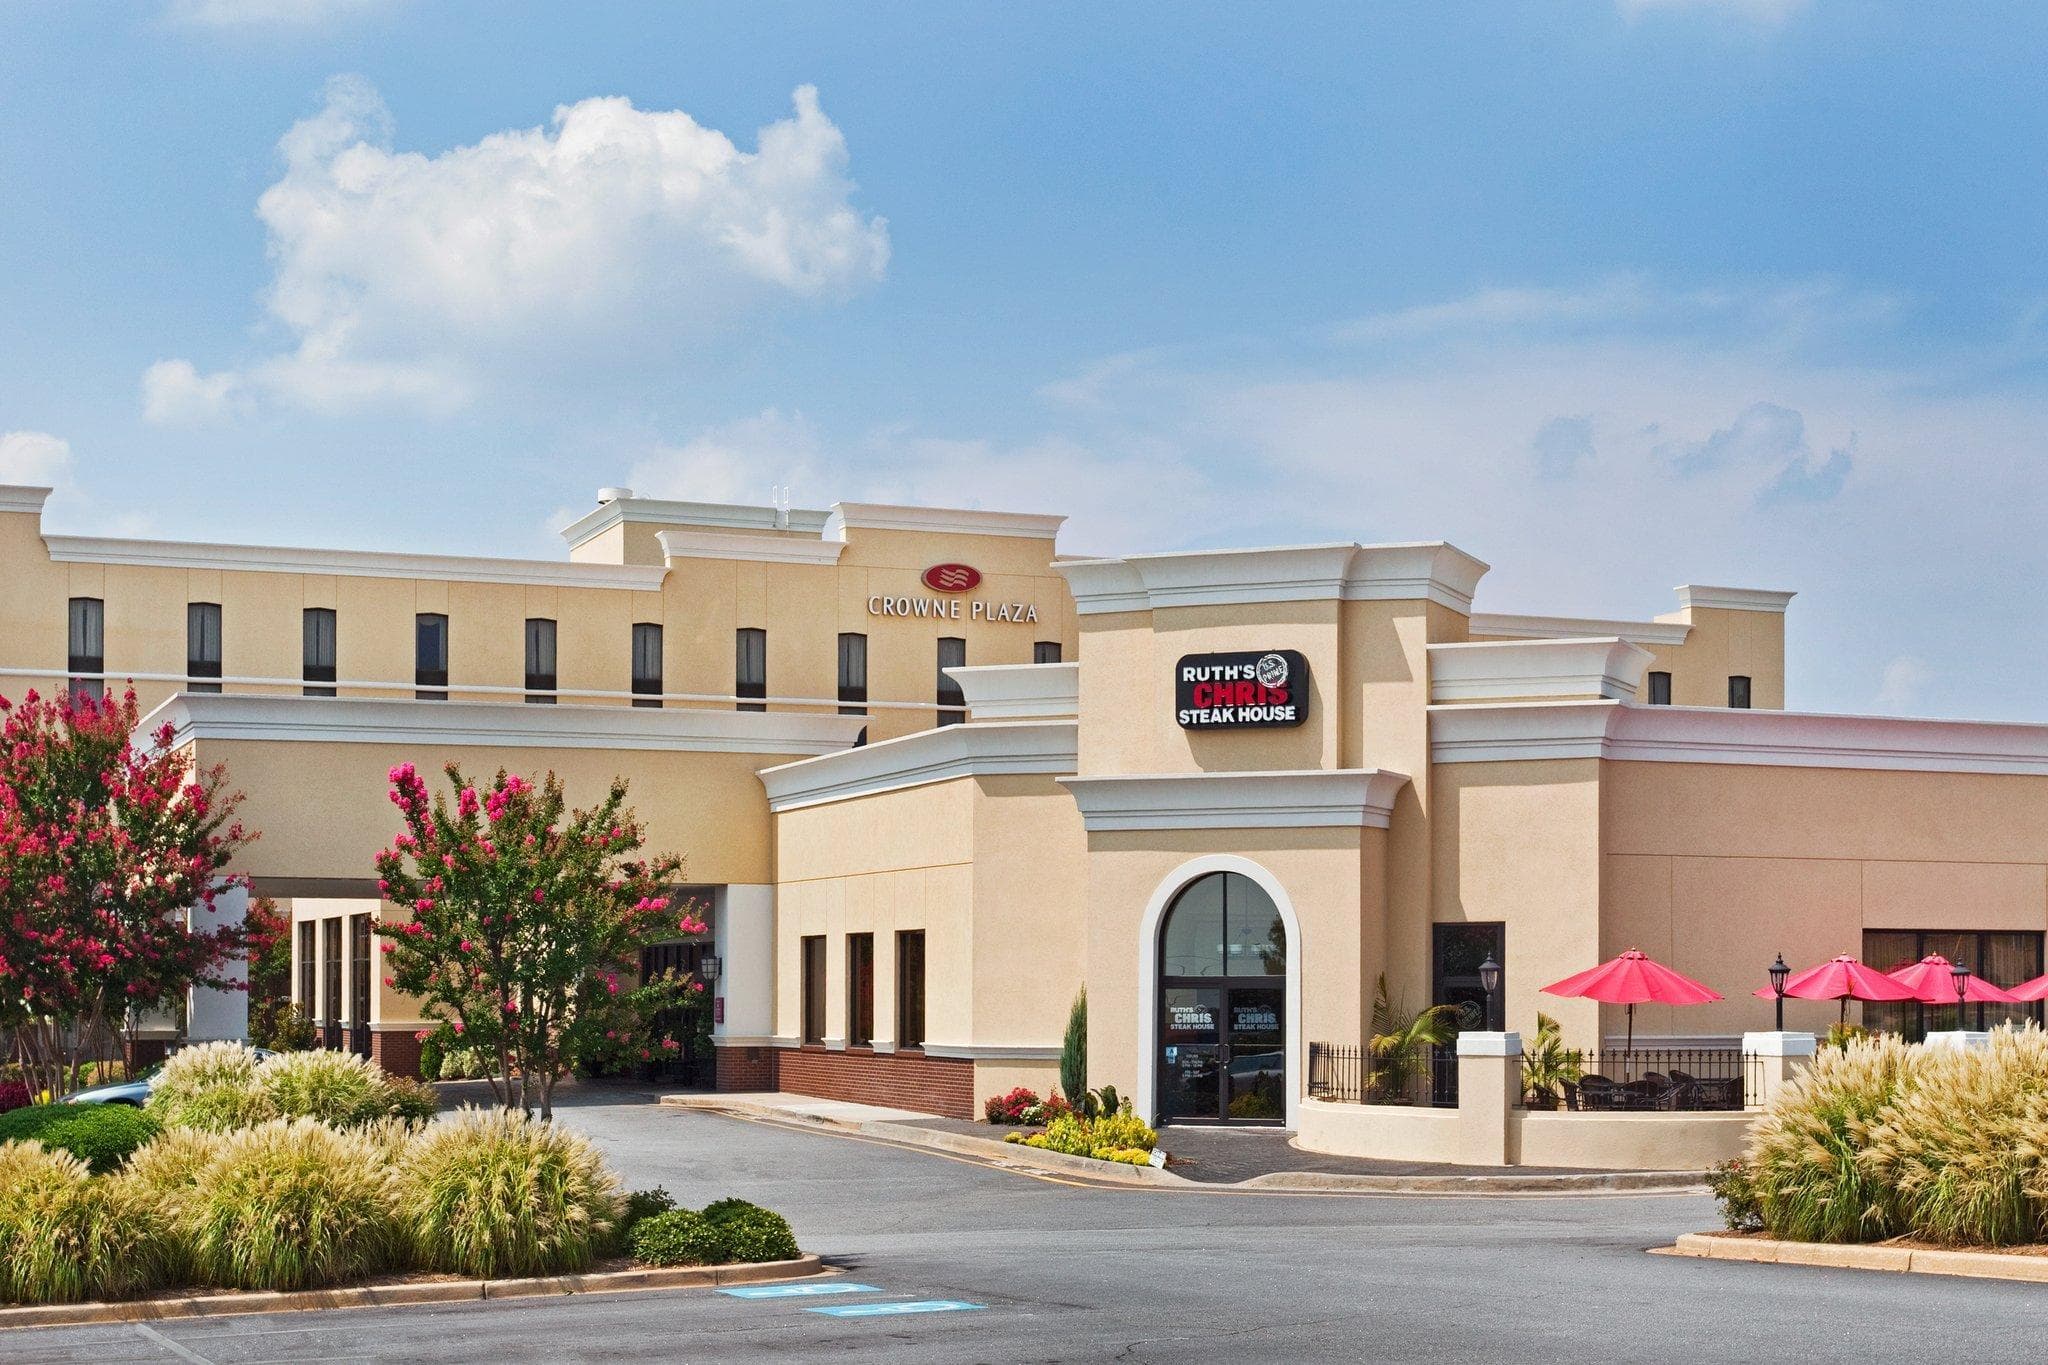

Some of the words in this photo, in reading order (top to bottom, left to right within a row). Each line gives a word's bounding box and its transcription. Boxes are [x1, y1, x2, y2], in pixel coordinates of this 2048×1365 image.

[868, 596, 961, 619] CROWNE
[973, 602, 1038, 623] PLAZA
[1183, 665, 1255, 682] RUTH'S
[1262, 665, 1285, 683] PRIME
[1193, 682, 1288, 708] CHRIS
[1179, 709, 1234, 724] STEAK
[1238, 706, 1296, 722] HOUSE
